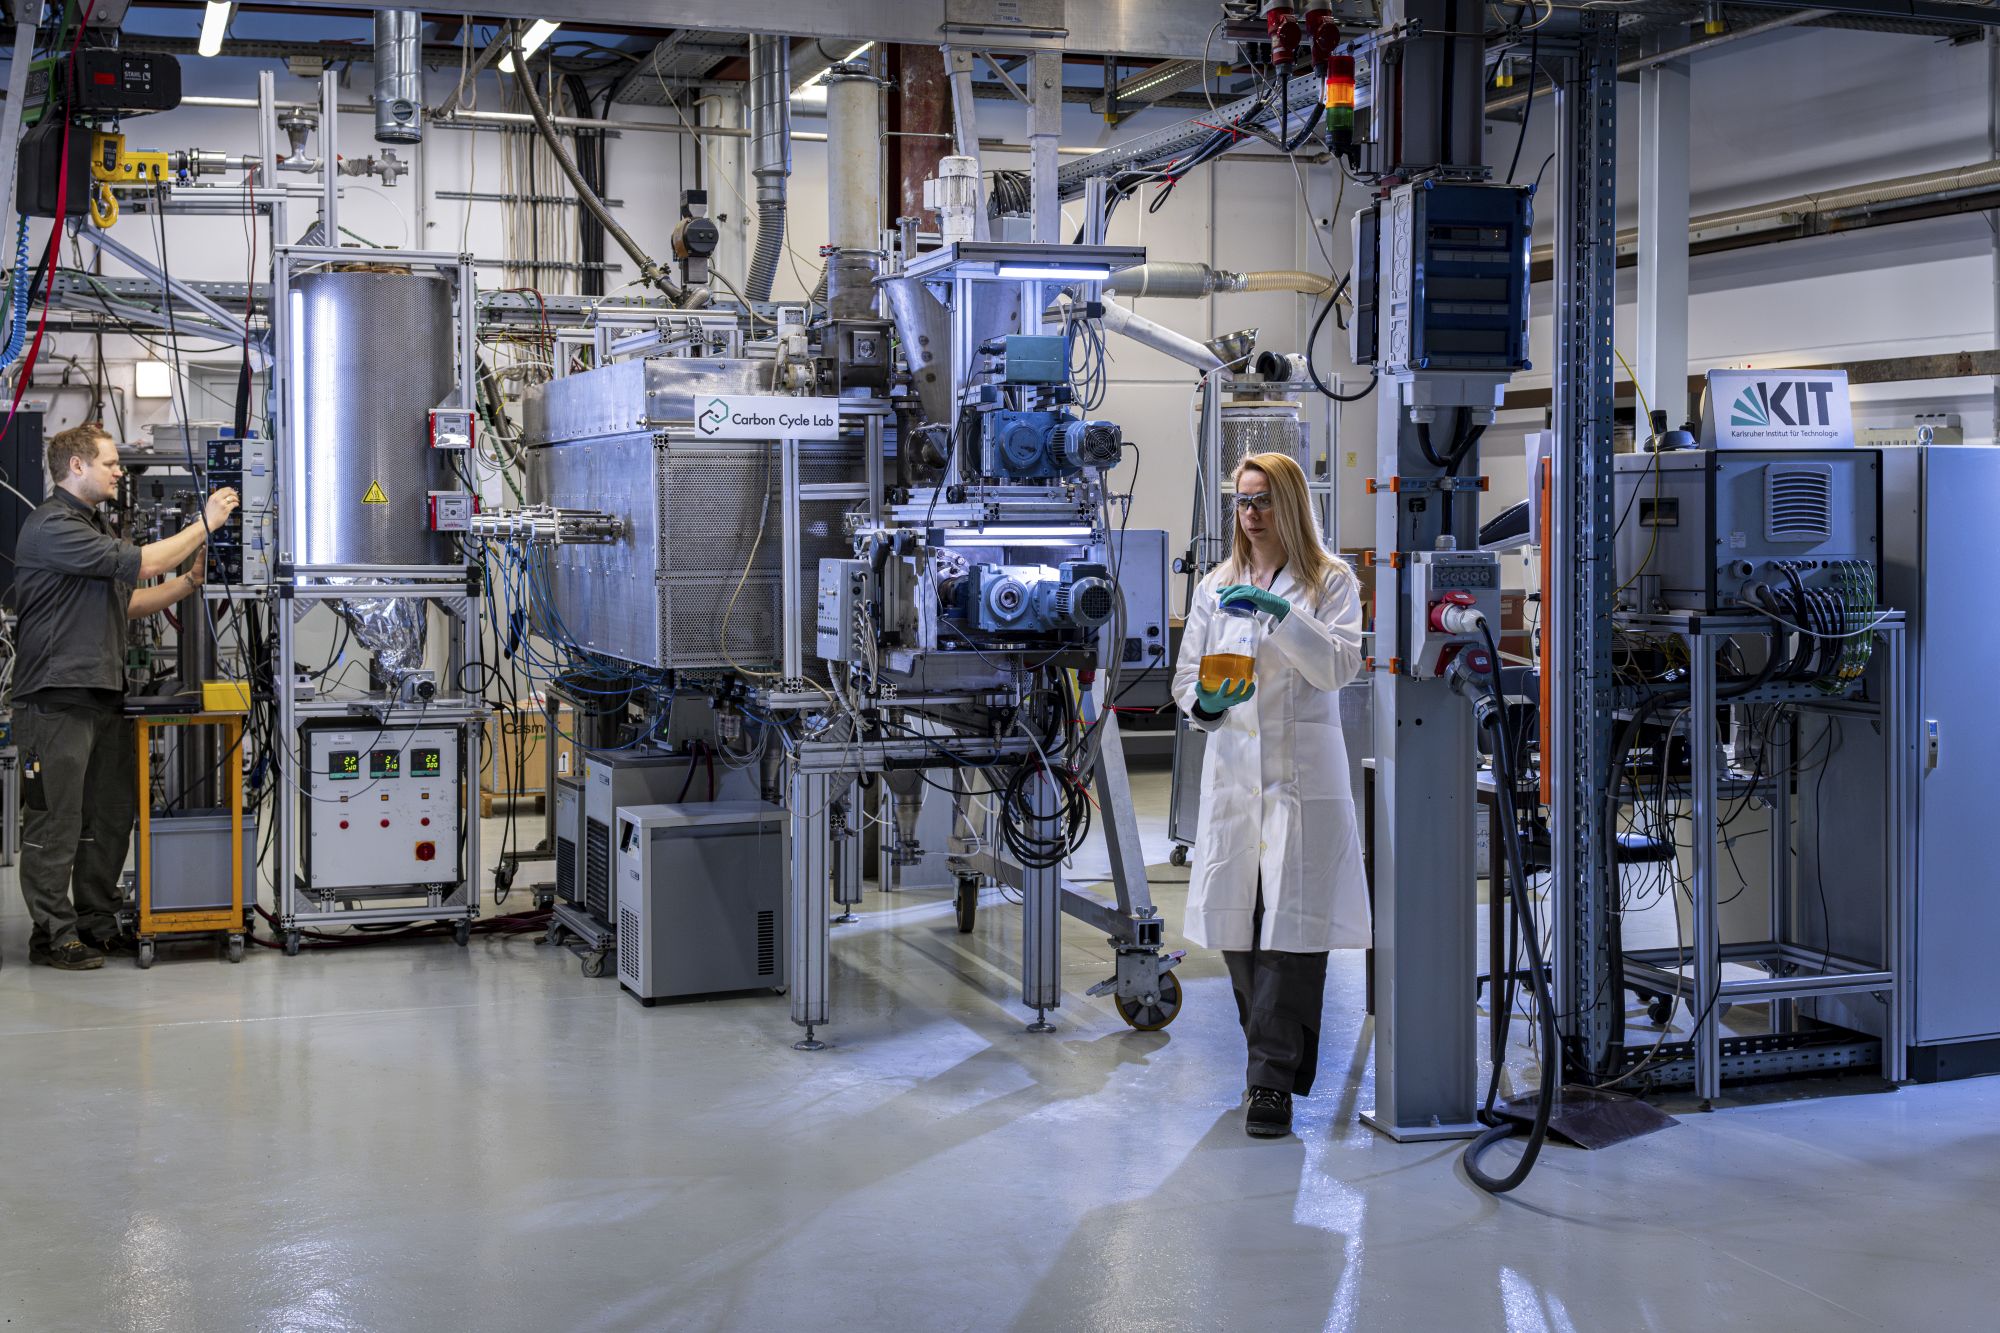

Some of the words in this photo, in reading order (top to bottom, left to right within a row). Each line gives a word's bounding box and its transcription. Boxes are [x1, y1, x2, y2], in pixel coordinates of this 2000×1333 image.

[1757, 381, 1833, 426] KIT
[732, 413, 775, 426] Carbon
[778, 414, 810, 429] Cycle
[813, 415, 834, 427] Lab
[1731, 430, 1765, 438] Karlsruher
[1789, 429, 1799, 437] für
[1801, 430, 1839, 439] Technologie
[504, 722, 547, 735] Casm
[344, 756, 356, 765] 22
[425, 754, 438, 762] 22
